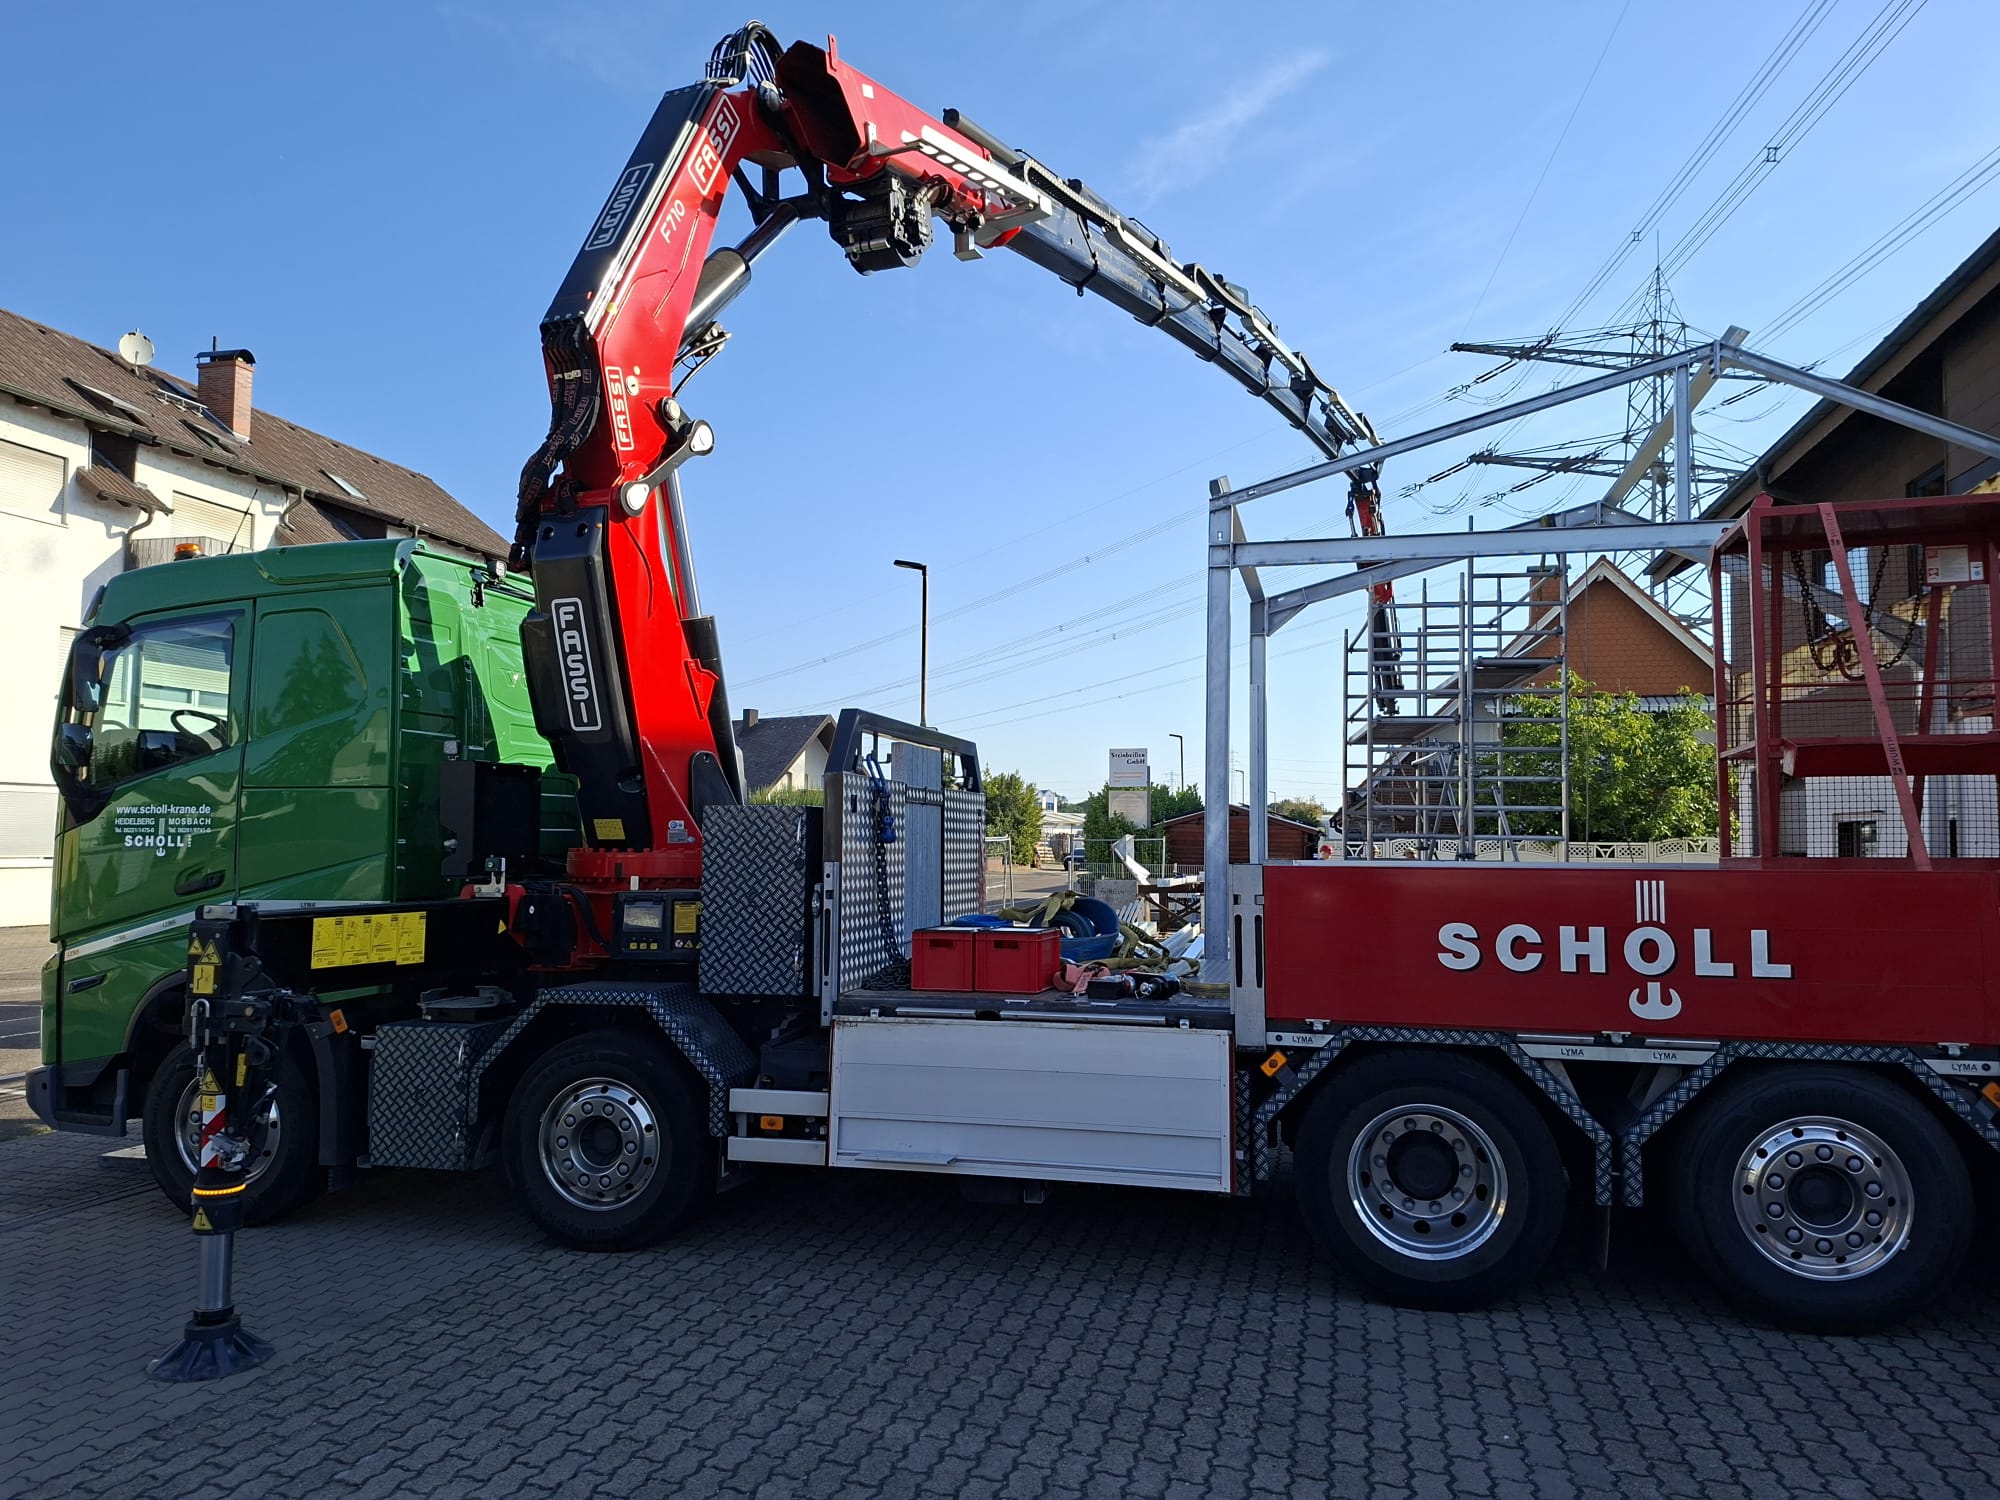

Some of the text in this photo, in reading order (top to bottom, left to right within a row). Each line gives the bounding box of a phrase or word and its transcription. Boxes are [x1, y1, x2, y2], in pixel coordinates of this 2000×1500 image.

[695, 106, 734, 183] FASSI
[593, 169, 640, 244] FASSI
[660, 199, 686, 244] F710
[609, 374, 630, 443] FASSI
[559, 605, 590, 723] FASSI
[116, 804, 211, 814] www.scholl-krane.de
[124, 835, 185, 847] SCHOLL
[1437, 922, 1793, 979] SCHOLL
[1292, 1035, 1314, 1044] LYMA
[1560, 1048, 1584, 1056] LYMA
[1653, 1052, 1677, 1060] LYMA
[1951, 1063, 1978, 1072] LYMA
